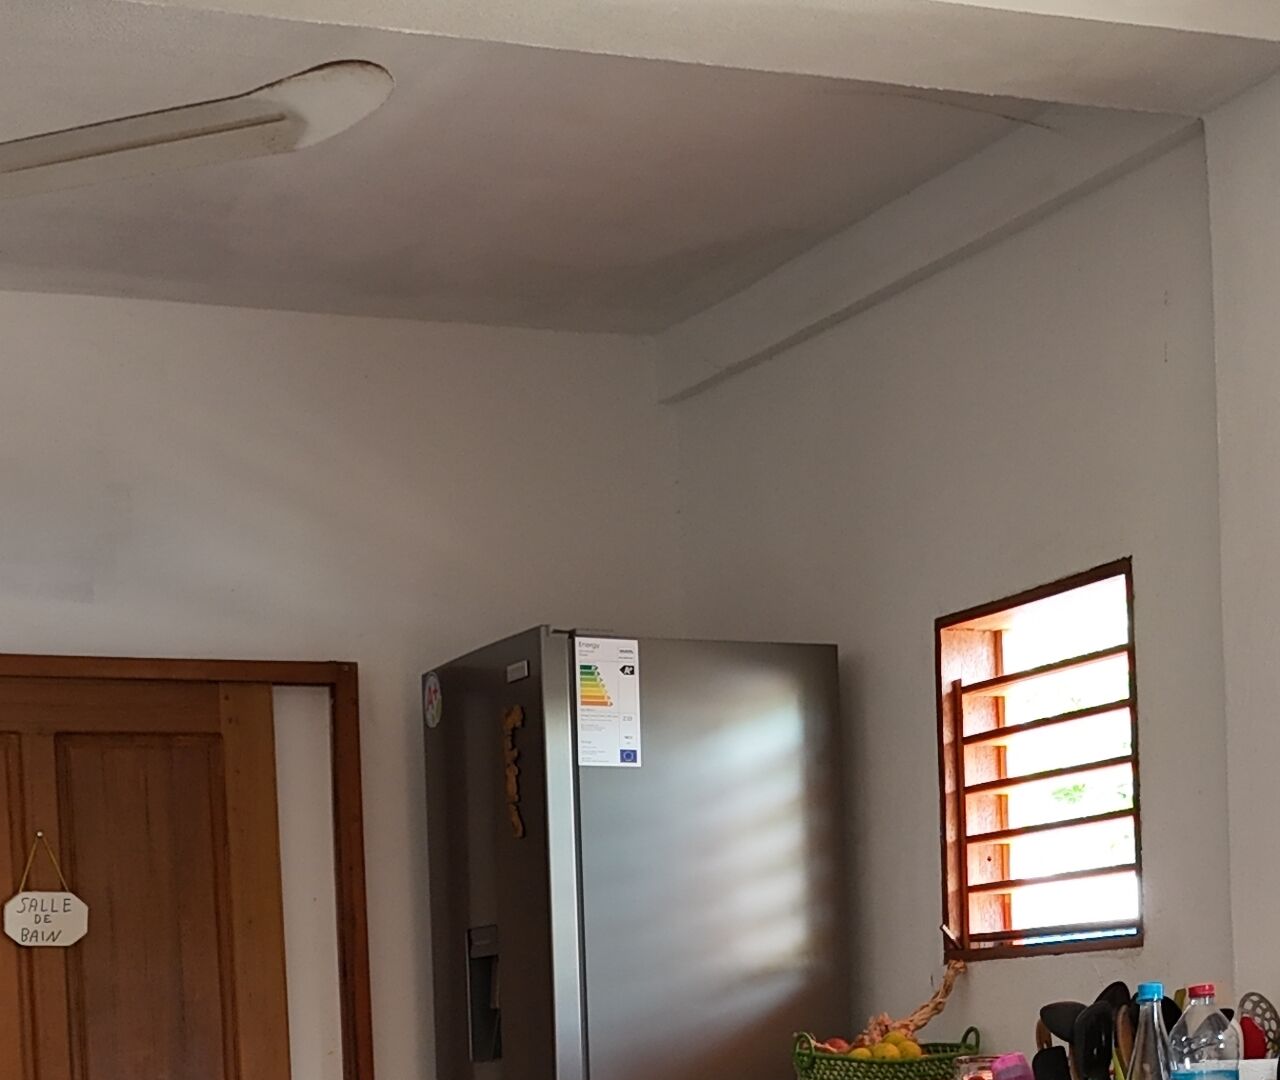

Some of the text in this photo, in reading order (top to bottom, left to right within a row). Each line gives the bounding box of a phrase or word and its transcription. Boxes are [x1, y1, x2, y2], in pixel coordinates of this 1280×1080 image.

[16, 897, 72, 914] SALLE
[34, 914, 52, 924] DE
[21, 928, 62, 942] BAIN
